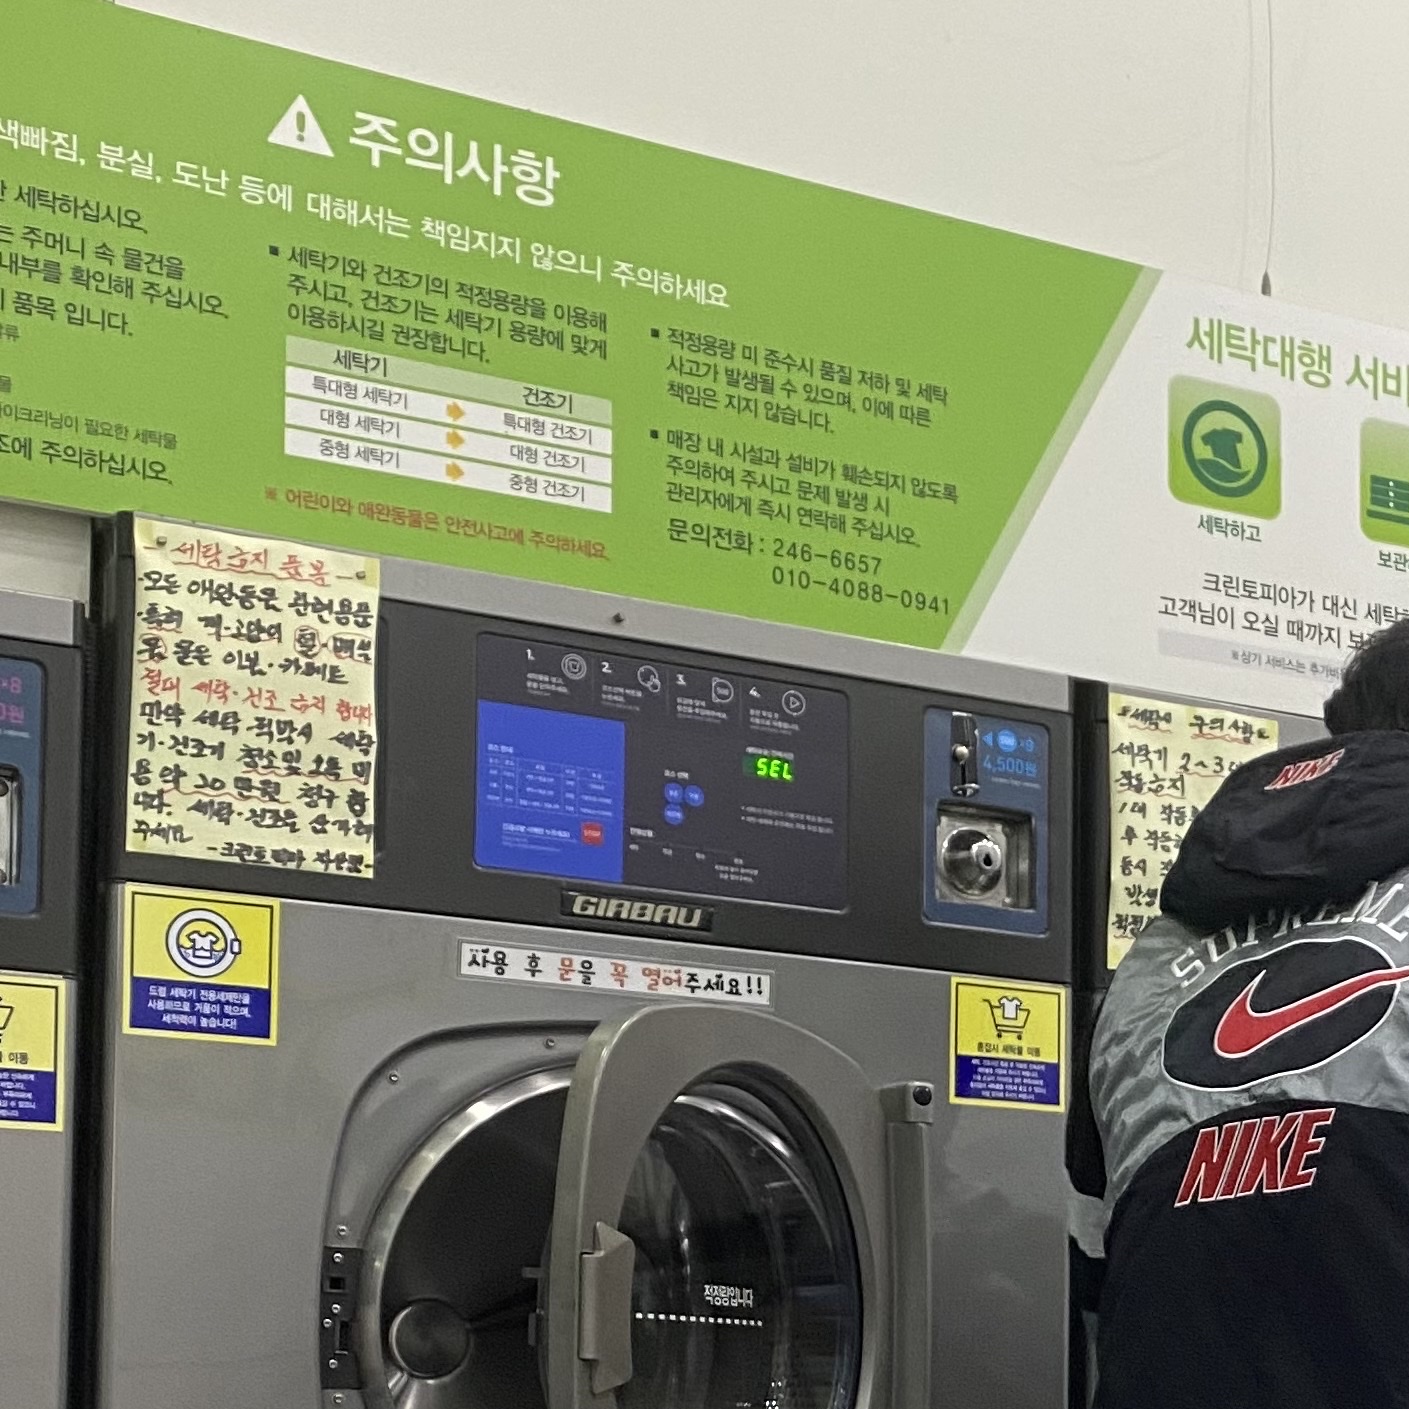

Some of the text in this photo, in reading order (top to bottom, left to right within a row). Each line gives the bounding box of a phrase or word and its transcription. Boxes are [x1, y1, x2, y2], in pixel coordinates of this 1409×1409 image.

[349, 111, 561, 207] 주의사항
[0, 118, 730, 308] 색빠짐, 분실, 도난 등에 대해서는 책임지지 않으니 주의하세요
[14, 184, 148, 235] 세탁하십시오.
[21, 225, 185, 281] 주머니 속 물건을
[12, 291, 134, 336] 품목 입니다.
[70, 264, 230, 319] 확인해 주십시오.
[287, 247, 607, 333] 세탁기와 건조기의 적정용량을 이용해
[287, 274, 608, 360] 주시고, 건조기는 세탁기 용량에 맞게
[287, 302, 491, 365] 이용하시길 권장합니다.
[1186, 316, 1332, 389] 세탁대행
[333, 348, 573, 415] 세탁기 건조기
[667, 327, 949, 406] 적정용량 미 준수시 품질 저하 및 세탁
[667, 353, 932, 428] 사고가 발생될 수 있으며, 이에 따른
[667, 381, 835, 435] 책임은 지지 않습니다.
[40, 440, 174, 486] 주의하십시오.
[667, 429, 701, 458] 매장
[707, 438, 724, 458] 내
[729, 442, 781, 469] 시설과
[785, 452, 837, 481] 설비가
[910, 476, 959, 505] 않도록
[667, 455, 890, 517] 주의하여 주시고 문제 발생 시
[667, 481, 920, 548] 관리자에게 즉시 연락해 주십시오.
[1198, 514, 1262, 543] 세탁하고
[772, 538, 883, 575] 246-6657
[771, 566, 951, 616] 010-4088-0941
[1203, 572, 1358, 621] 크린토피아가 대신
[1157, 595, 1342, 650] 고객님이 오실 때까지
[757, 757, 793, 781] SEL
[1264, 748, 1345, 790] NIKE
[572, 895, 702, 928] GIRBAU
[467, 948, 509, 976] 사용
[524, 953, 543, 977] 후
[557, 957, 595, 986] 문을
[610, 961, 628, 988] 꼭
[1174, 1107, 1336, 1208] NIKE
